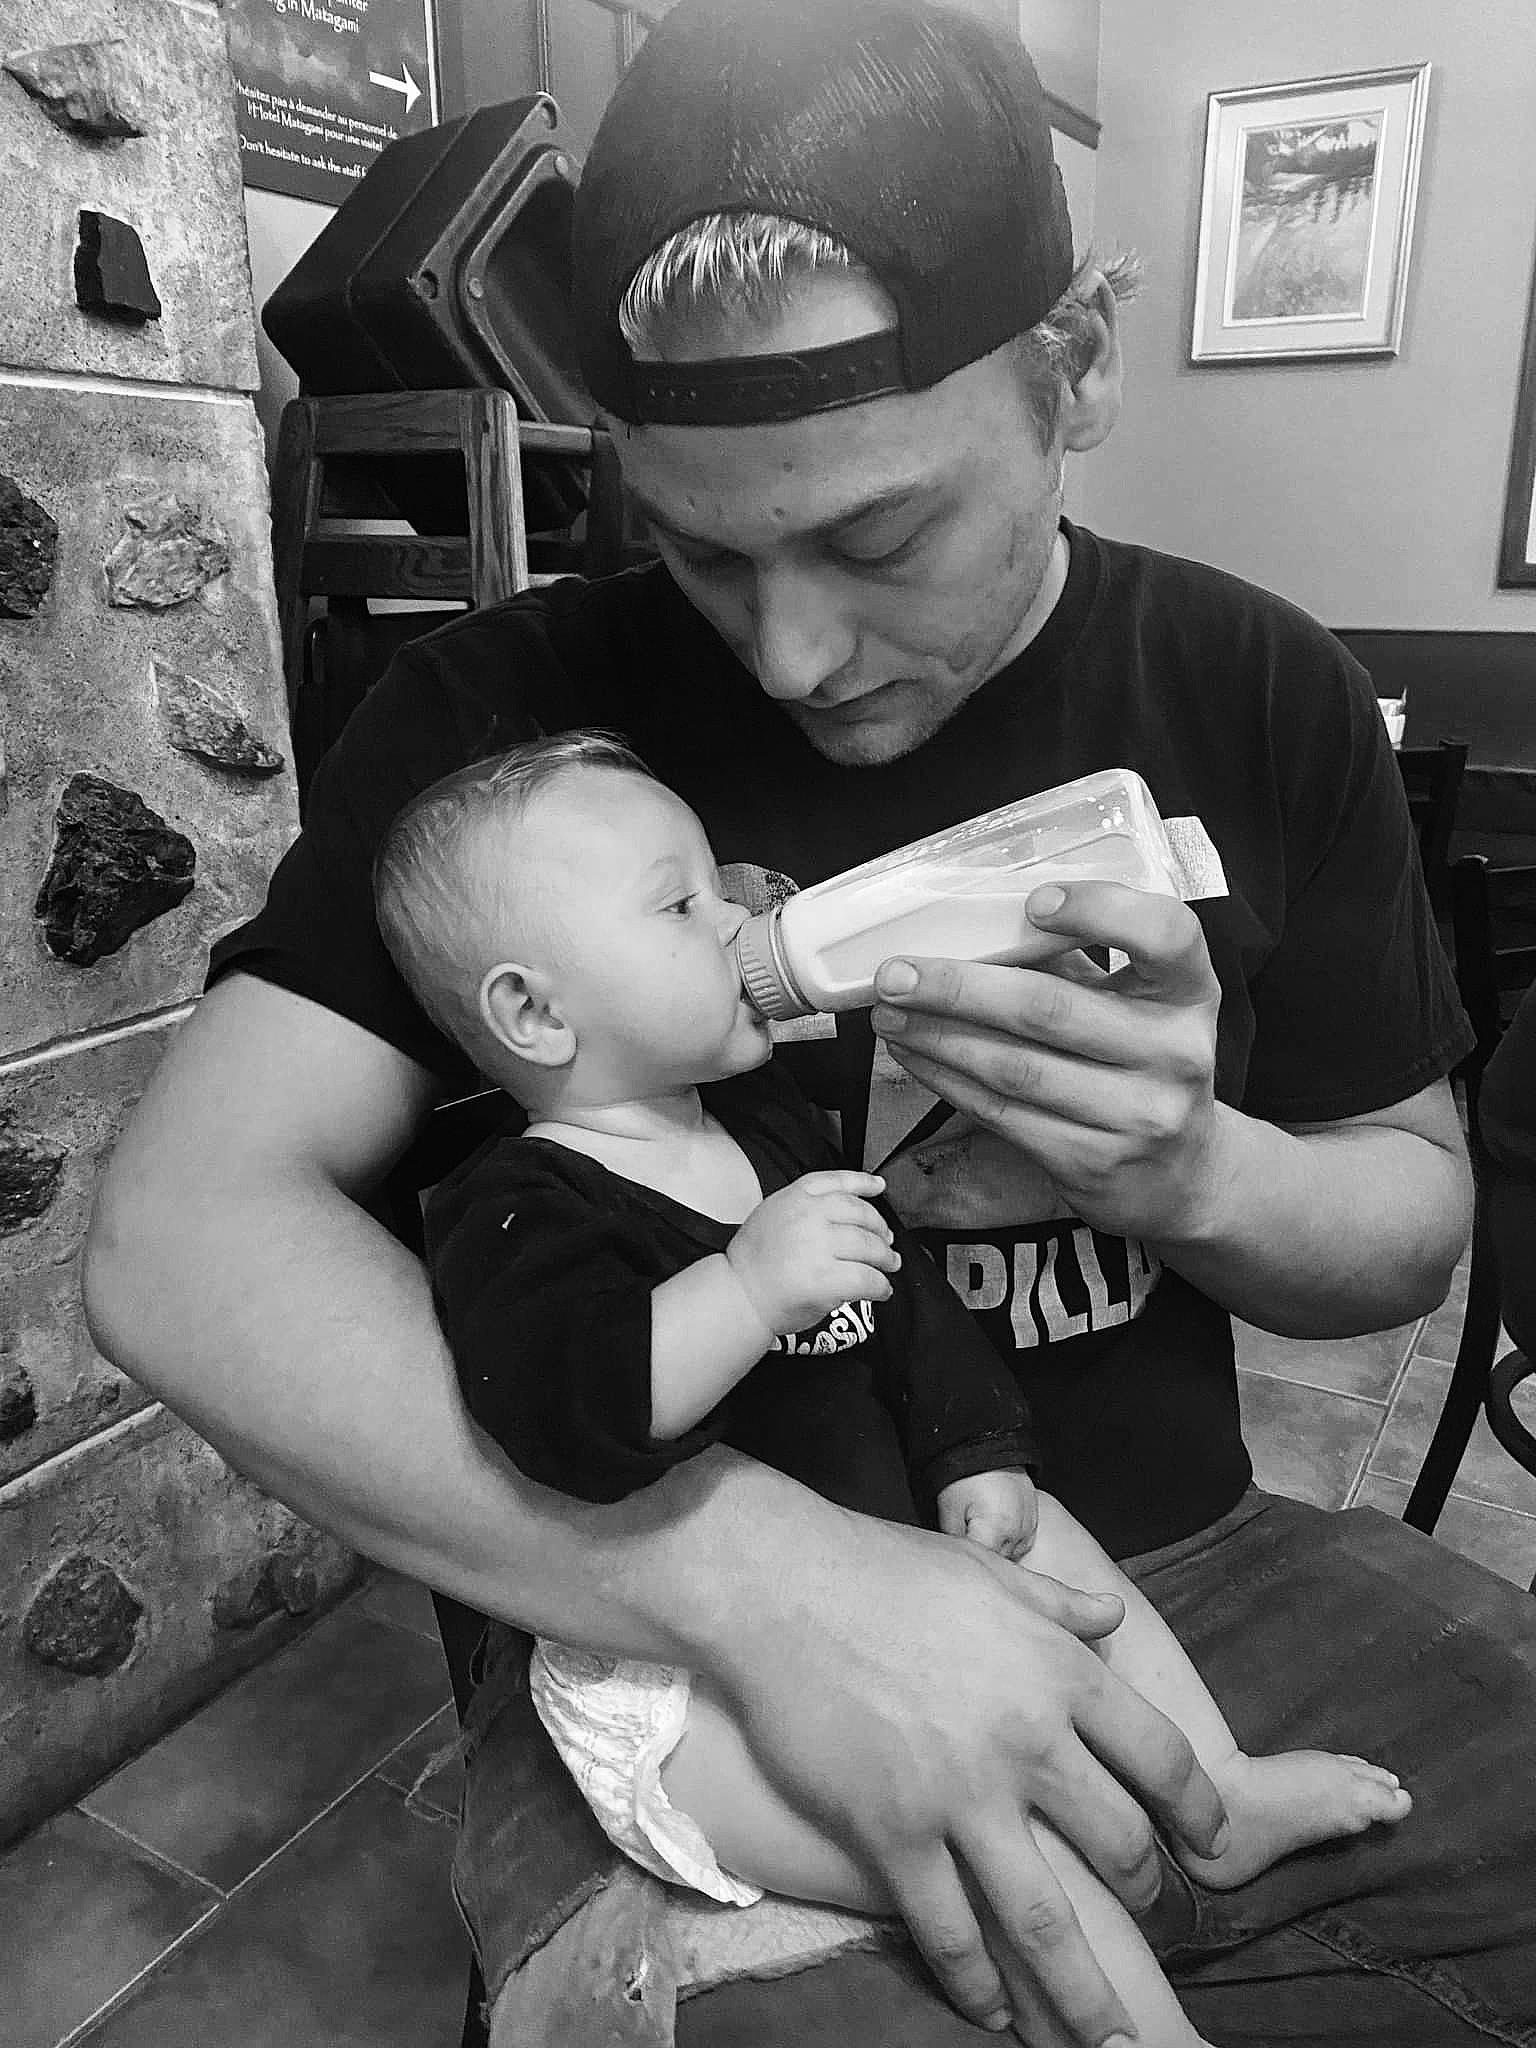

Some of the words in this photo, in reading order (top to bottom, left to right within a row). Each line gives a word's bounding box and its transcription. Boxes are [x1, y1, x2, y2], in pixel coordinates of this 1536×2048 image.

[301, 0, 360, 33] Matagami
[271, 95, 288, 110] pas
[296, 97, 336, 121] demander
[337, 114, 348, 126] au
[348, 118, 387, 137] personnel
[281, 109, 323, 136] Matagami
[324, 128, 344, 142] pour
[345, 134, 360, 146] une
[264, 139, 300, 163] hesitate
[300, 152, 311, 166] to
[311, 154, 327, 170] ask
[327, 157, 341, 174] the
[342, 163, 361, 178] staff
